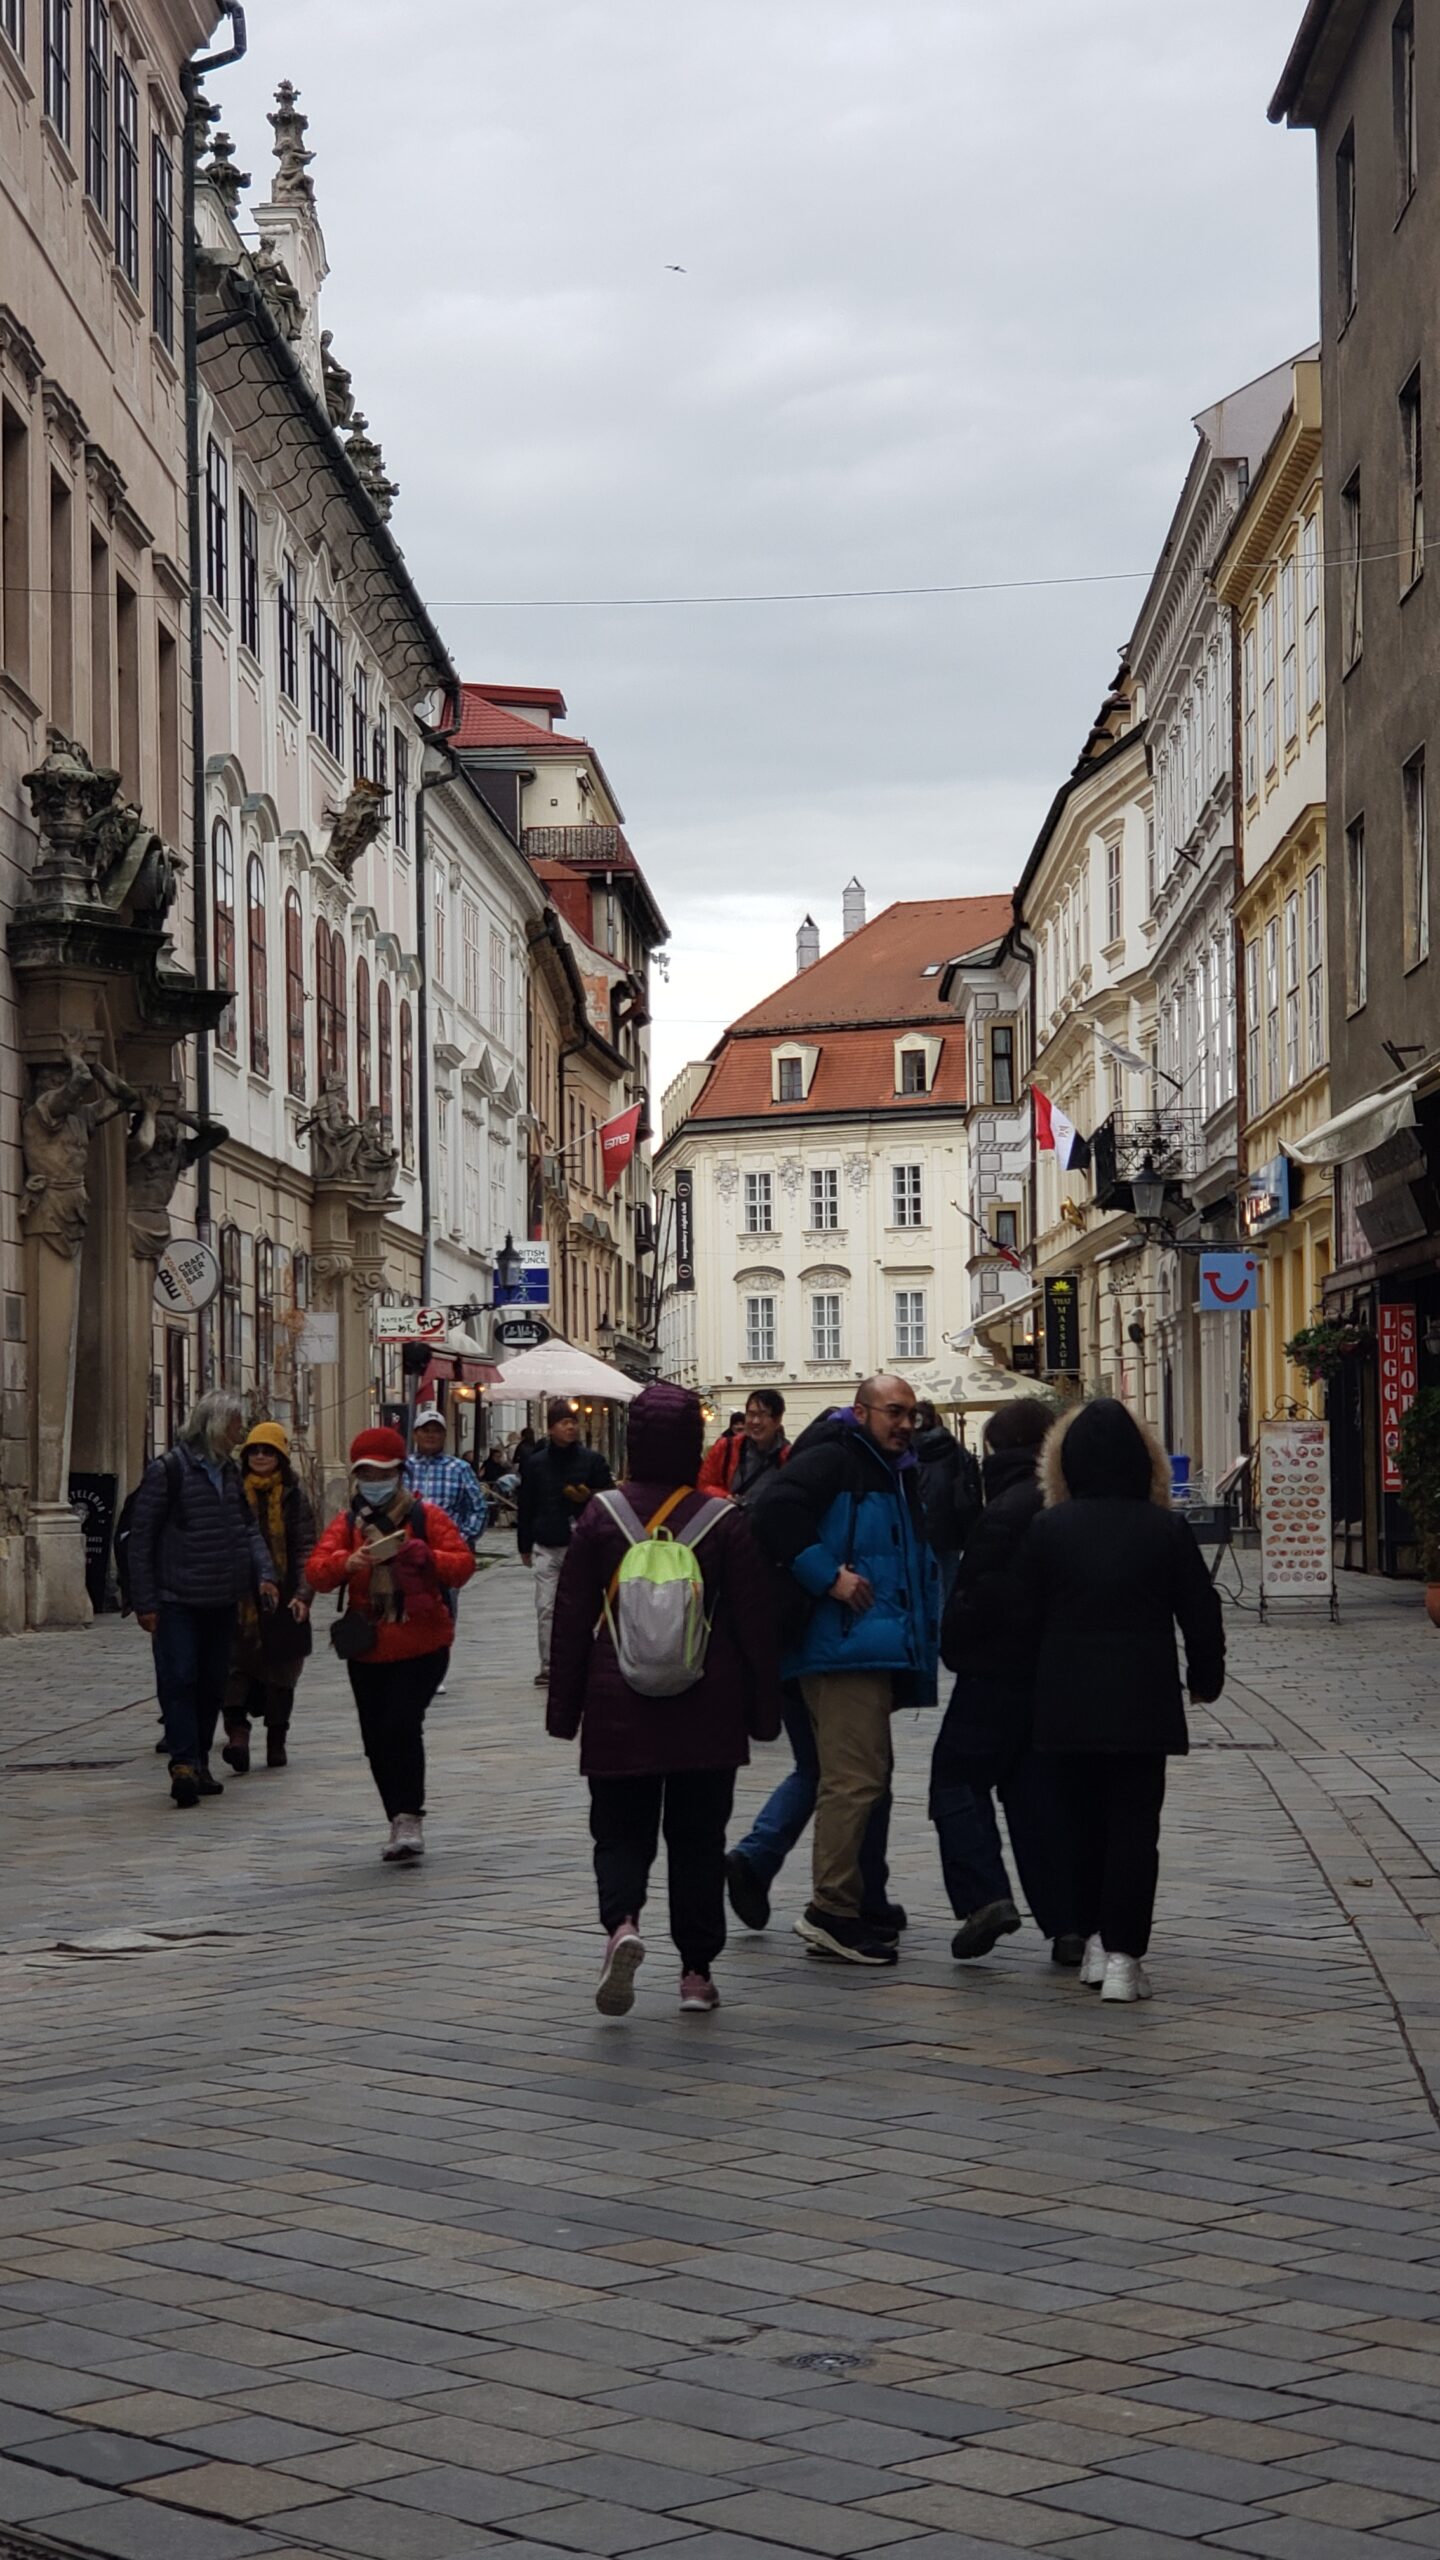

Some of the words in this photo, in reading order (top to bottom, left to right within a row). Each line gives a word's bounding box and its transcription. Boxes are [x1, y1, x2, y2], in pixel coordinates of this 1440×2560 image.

[178, 1251, 206, 1272] CRAFT
[519, 1249, 546, 1257] RITISH
[182, 1261, 206, 1278] BEER
[185, 1270, 205, 1285] BAR
[158, 1269, 182, 1301] BE
[1057, 1306, 1068, 1367] MASSAGE
[1400, 1322, 1415, 1413] STOR
[1383, 1311, 1400, 1474] LUGGAGE
